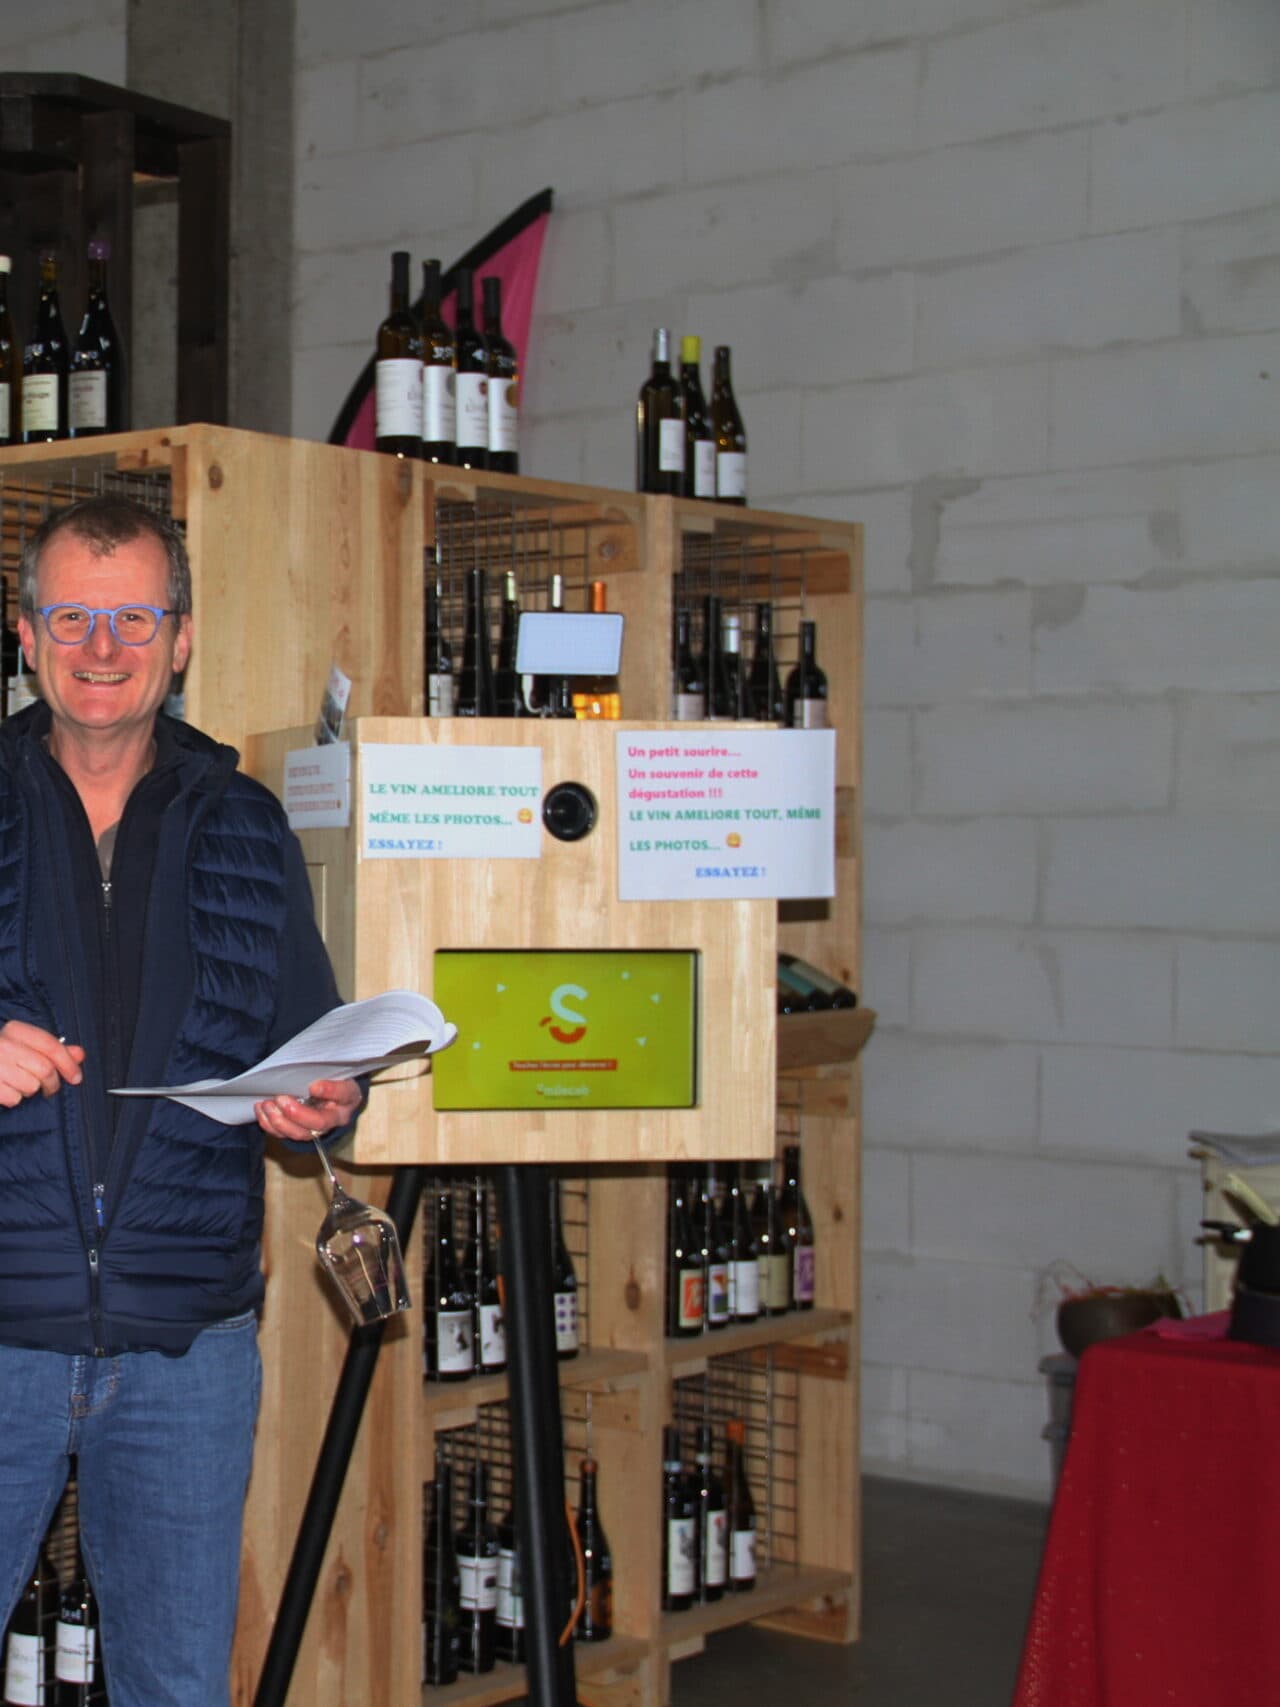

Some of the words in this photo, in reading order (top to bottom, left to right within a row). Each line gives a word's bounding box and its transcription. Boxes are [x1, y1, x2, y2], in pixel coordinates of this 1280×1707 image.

[628, 747, 645, 758] Un
[648, 746, 679, 760] petit
[628, 768, 646, 779] Un
[650, 768, 704, 779] souvenir
[708, 768, 724, 779] de
[727, 768, 759, 779] cette
[369, 784, 386, 794] LE
[391, 784, 417, 795] VIN
[421, 785, 496, 796] AMELIORE
[500, 786, 539, 797] TOUT
[628, 787, 704, 802] dégustation
[708, 787, 723, 798] !!!
[369, 811, 410, 824] MÊME
[415, 813, 440, 824] LES
[444, 814, 513, 826] PHOTOS...
[629, 810, 644, 821] LE
[647, 810, 671, 820] VIN
[674, 809, 740, 820] AMELIORE
[745, 808, 783, 821] TOUT,
[786, 804, 821, 820] MÊME
[368, 839, 435, 850] ESSAYEZ
[438, 840, 443, 850] !
[630, 840, 651, 851] LES
[695, 866, 760, 879] ESSAYEZ
